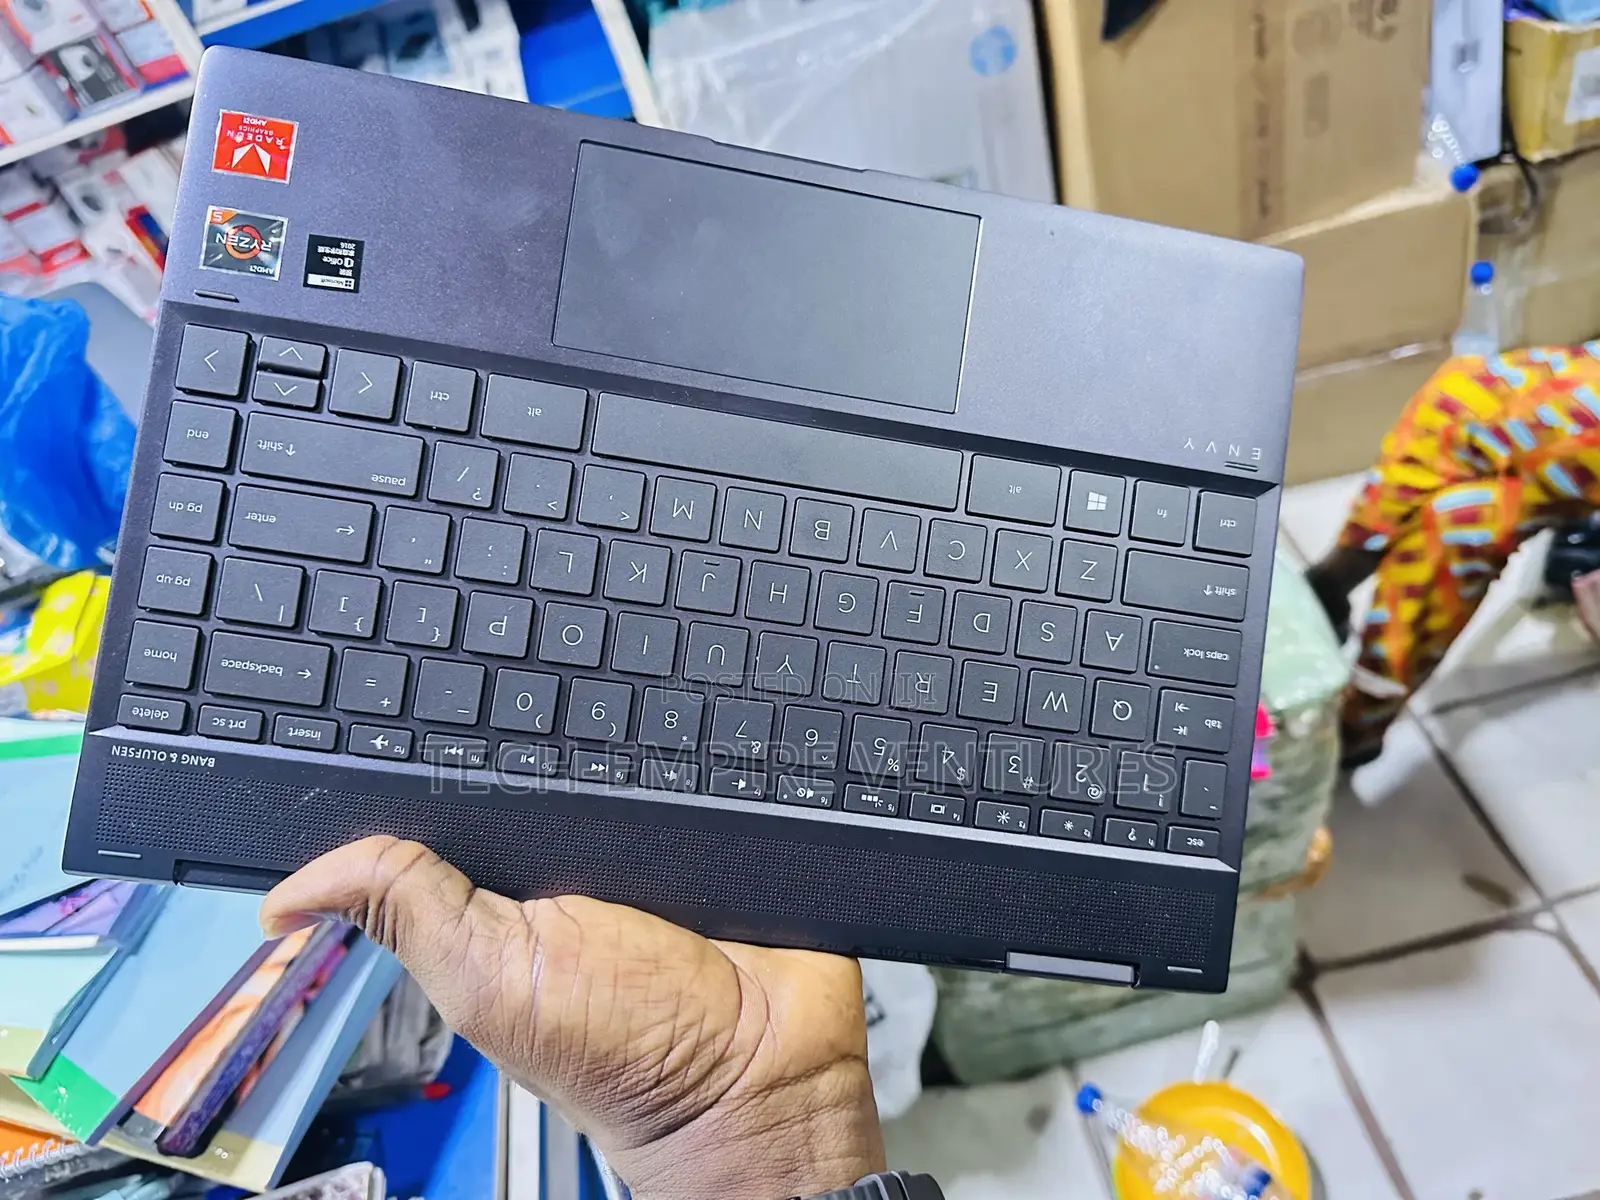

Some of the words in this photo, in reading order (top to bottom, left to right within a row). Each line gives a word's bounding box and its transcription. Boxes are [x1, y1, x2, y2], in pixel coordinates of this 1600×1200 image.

[249, 117, 268, 126] AMD
[226, 129, 285, 146] RADEON
[238, 125, 274, 135] GRAPHICS
[212, 211, 223, 222] 5
[215, 232, 272, 252] RYZEN
[340, 241, 356, 249] 2016
[322, 256, 343, 266] Office
[256, 264, 276, 275] AMD
[320, 278, 344, 286] Microsoft
[430, 390, 450, 401] ctrl
[526, 406, 542, 418] alt
[187, 428, 209, 440] end
[258, 439, 283, 451] shift
[1184, 437, 1261, 460] ENVY
[371, 473, 406, 486] pause
[472, 487, 482, 500] ?
[1008, 484, 1022, 494] alt
[169, 500, 184, 512] dn
[187, 502, 203, 514] pg
[672, 498, 694, 520] M
[1157, 508, 1167, 518] fn
[245, 512, 276, 524] enter
[743, 508, 763, 531] N
[1219, 518, 1236, 528] ctrl
[814, 519, 831, 540] B
[880, 530, 898, 551] V
[947, 540, 966, 560] C
[558, 551, 573, 574] L
[1014, 550, 1033, 571] X
[628, 561, 648, 584] K
[1080, 559, 1098, 581] Z
[156, 574, 172, 584] up
[174, 575, 191, 587] pg
[701, 572, 716, 593] J
[769, 582, 788, 604] H
[1214, 586, 1236, 596] shift
[838, 592, 856, 613] G
[906, 604, 923, 624] F
[488, 615, 508, 636] P
[972, 612, 991, 633] D
[562, 624, 584, 646] O
[1040, 621, 1056, 642] S
[1105, 630, 1124, 651] A
[144, 648, 178, 663] home
[707, 644, 726, 666] U
[1183, 647, 1205, 658] lock
[1206, 650, 1230, 661] caps
[221, 658, 284, 677] backspace
[776, 654, 794, 675] Y
[846, 663, 862, 684] T
[914, 672, 932, 694] R
[982, 680, 998, 703] E
[1042, 690, 1068, 713] W
[132, 706, 169, 720] delete
[590, 701, 606, 721] 9
[1112, 699, 1132, 721] Q
[212, 716, 226, 727] sc
[226, 717, 247, 730] prt
[664, 710, 679, 729] 8
[1204, 718, 1222, 730] tab
[288, 726, 322, 740] insert
[735, 720, 748, 738] 7
[804, 728, 819, 747] 6
[111, 744, 166, 762] OLUFSEN
[394, 745, 405, 755] f12
[750, 740, 762, 754] &
[874, 738, 887, 756] 5
[169, 752, 177, 762] &
[180, 753, 216, 768] BANG
[942, 746, 955, 764] 4
[887, 758, 899, 772] %
[1008, 755, 1022, 774] 3
[956, 767, 966, 781] $
[1075, 764, 1088, 783] 2
[1022, 776, 1034, 790] #
[1087, 784, 1102, 799] @
[1186, 837, 1206, 847] esc
